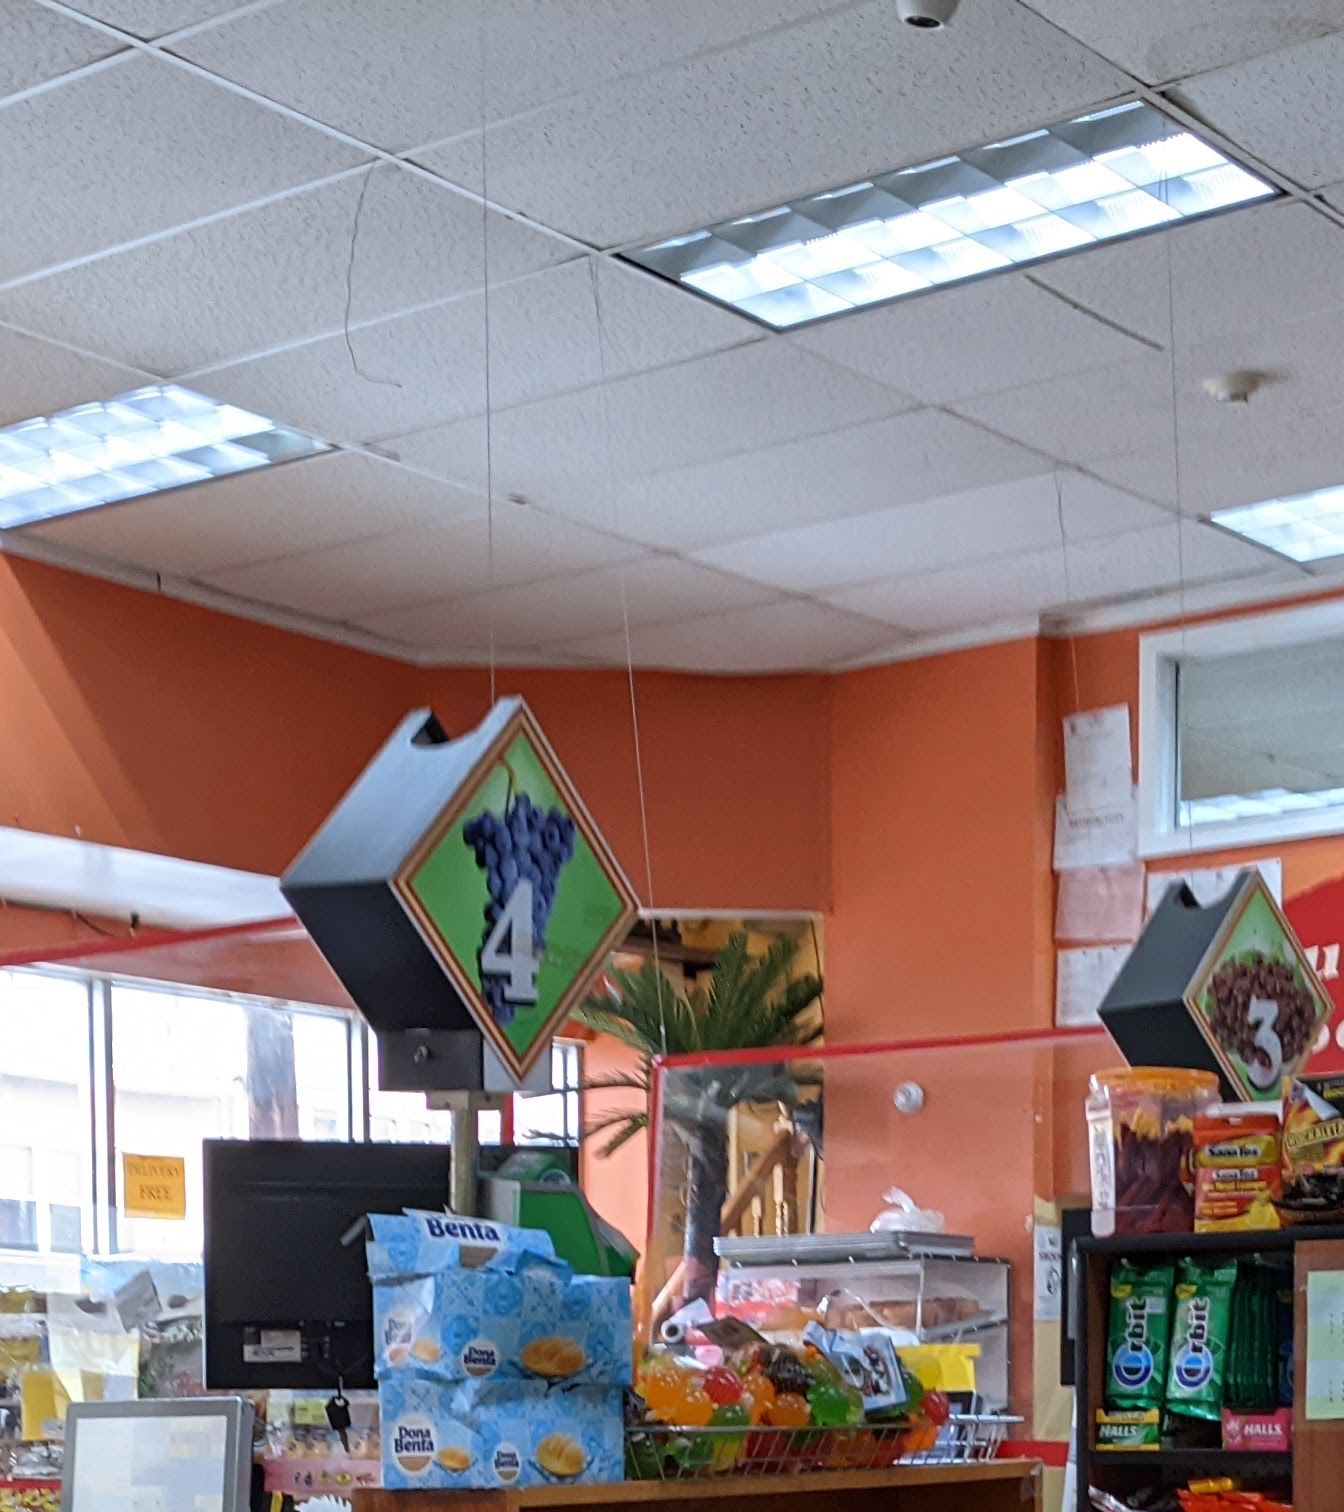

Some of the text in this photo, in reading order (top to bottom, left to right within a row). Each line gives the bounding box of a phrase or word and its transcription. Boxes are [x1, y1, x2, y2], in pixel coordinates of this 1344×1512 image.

[481, 877, 540, 1002] 4
[1246, 996, 1283, 1088] 3
[127, 1162, 180, 1177] DELIVERY
[138, 1184, 172, 1200] FREE
[425, 1217, 501, 1242] Benta
[1113, 1296, 1154, 1389] Orbit
[1174, 1296, 1214, 1391] Orbit
[467, 1346, 496, 1358] Dona
[463, 1354, 497, 1368] Benta
[398, 1426, 431, 1440] Dona
[1098, 1425, 1139, 1438] HALLS
[1243, 1423, 1282, 1435] HALLS
[394, 1437, 435, 1454] Benta
[496, 1450, 517, 1460] Dona
[494, 1458, 519, 1469] Benta
